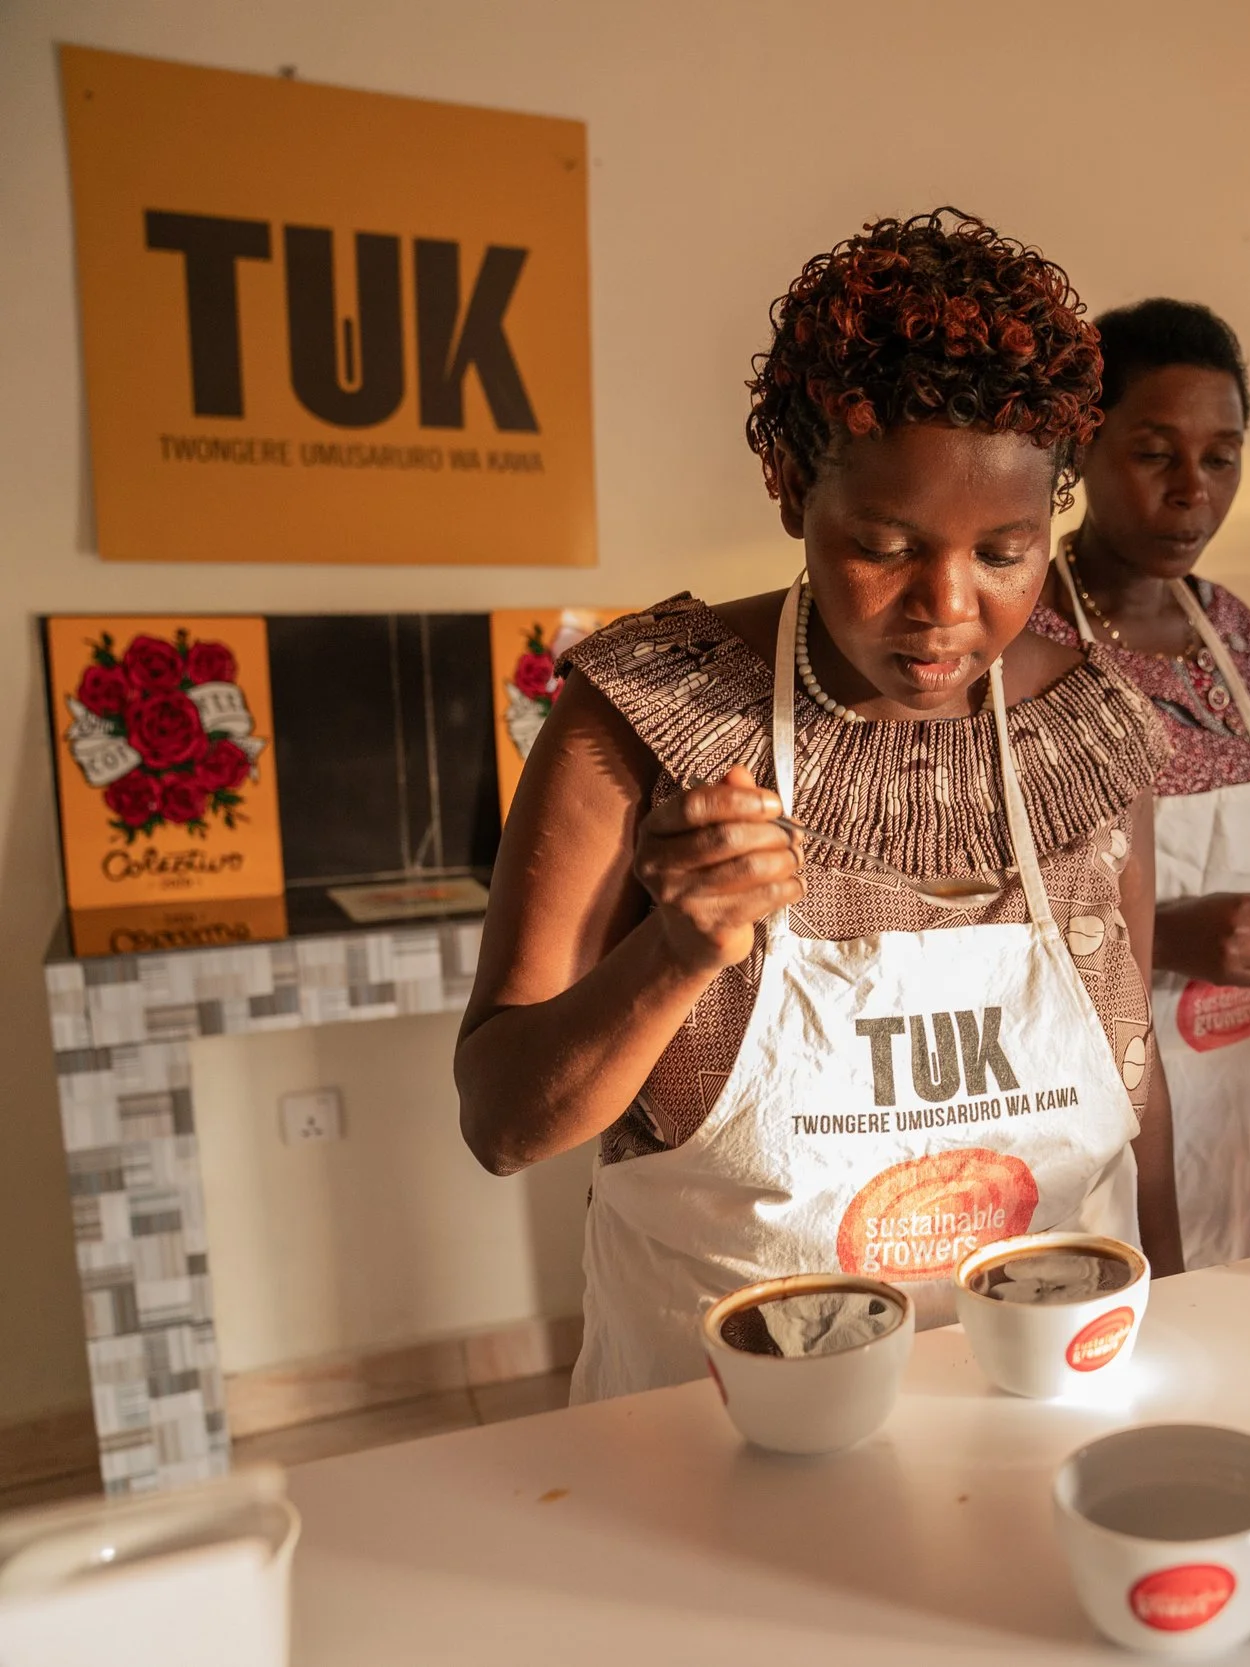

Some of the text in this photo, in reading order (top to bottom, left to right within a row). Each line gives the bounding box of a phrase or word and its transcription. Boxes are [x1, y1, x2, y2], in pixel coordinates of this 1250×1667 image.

[144, 209, 541, 434] TUK
[159, 434, 545, 475] TWONGERE UMUSARURO WA KAWA
[855, 1006, 1021, 1107] TUK
[791, 1086, 1080, 1135] TWONGERE UMUSARURO WA KAWA
[865, 1203, 1007, 1239] sustainable
